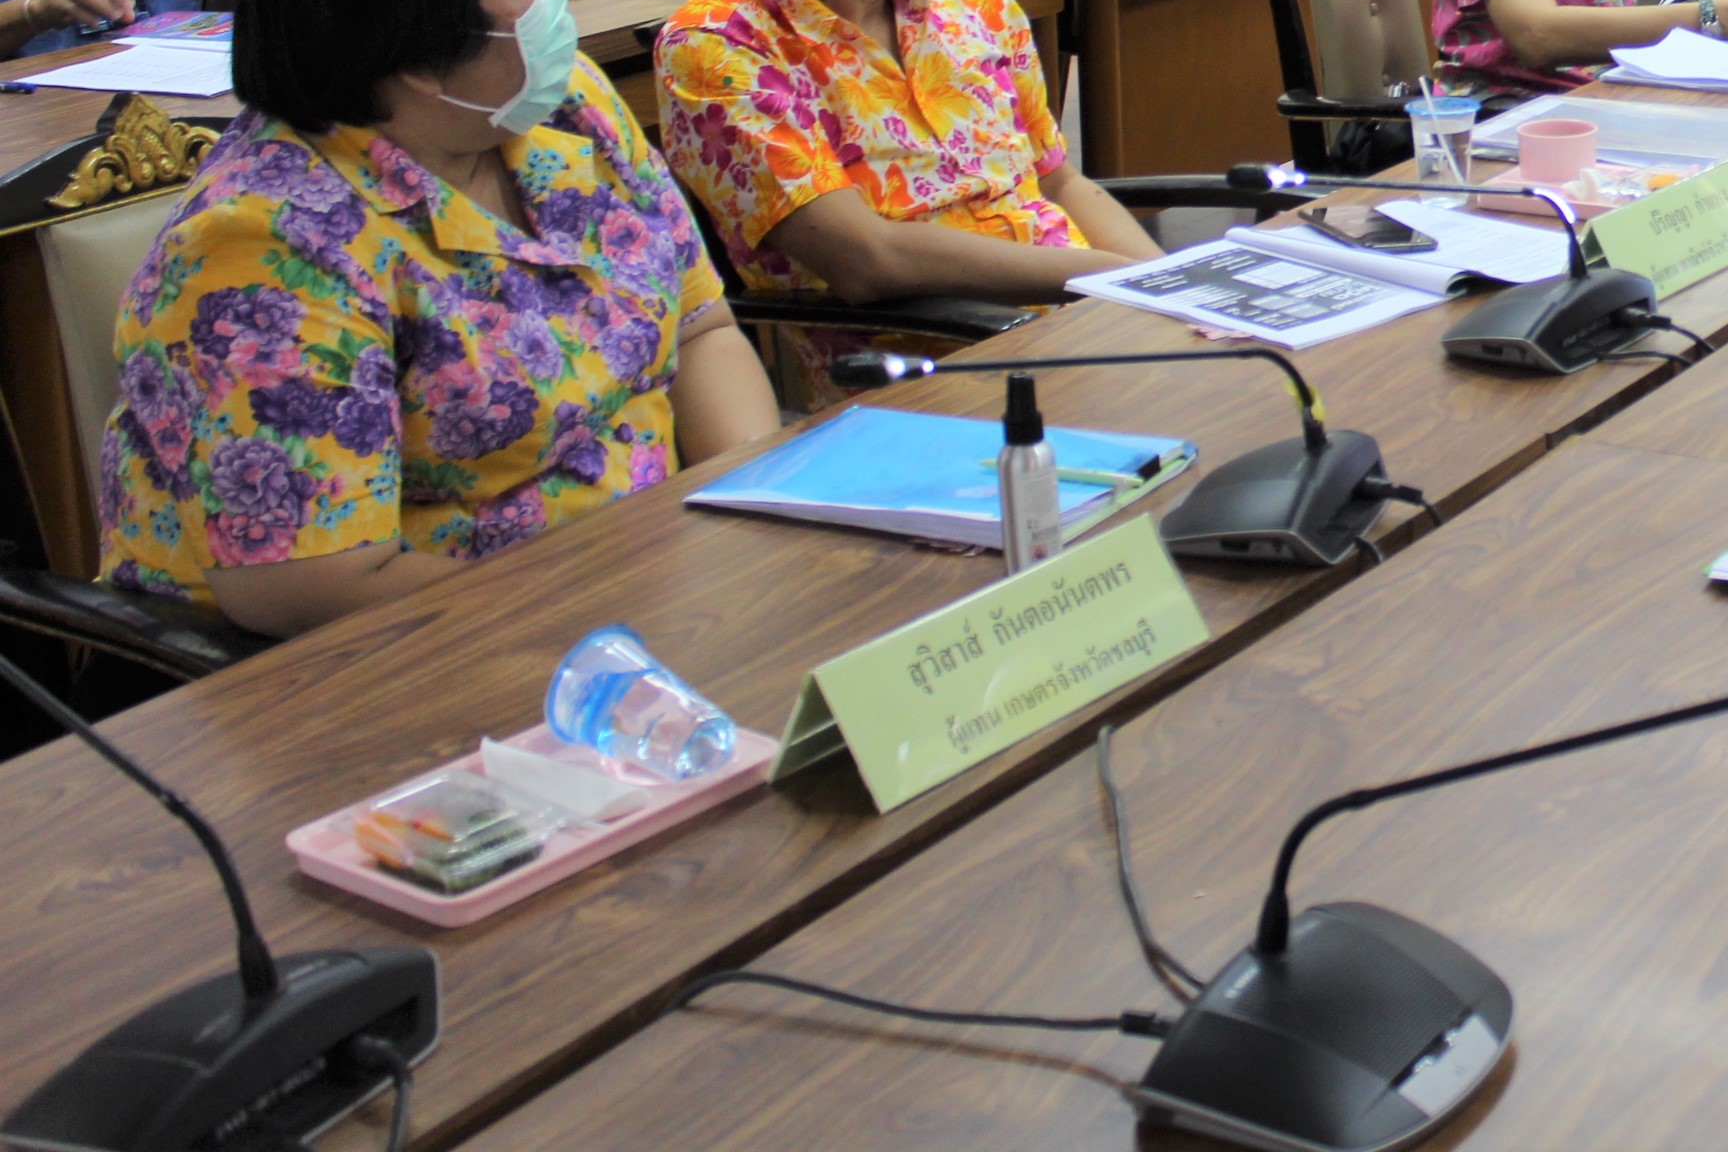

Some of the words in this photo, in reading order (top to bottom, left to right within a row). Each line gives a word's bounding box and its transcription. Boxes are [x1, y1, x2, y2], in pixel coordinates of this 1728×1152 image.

[1004, 617, 1156, 719] เกษตรจังหวัดชลบุรี
